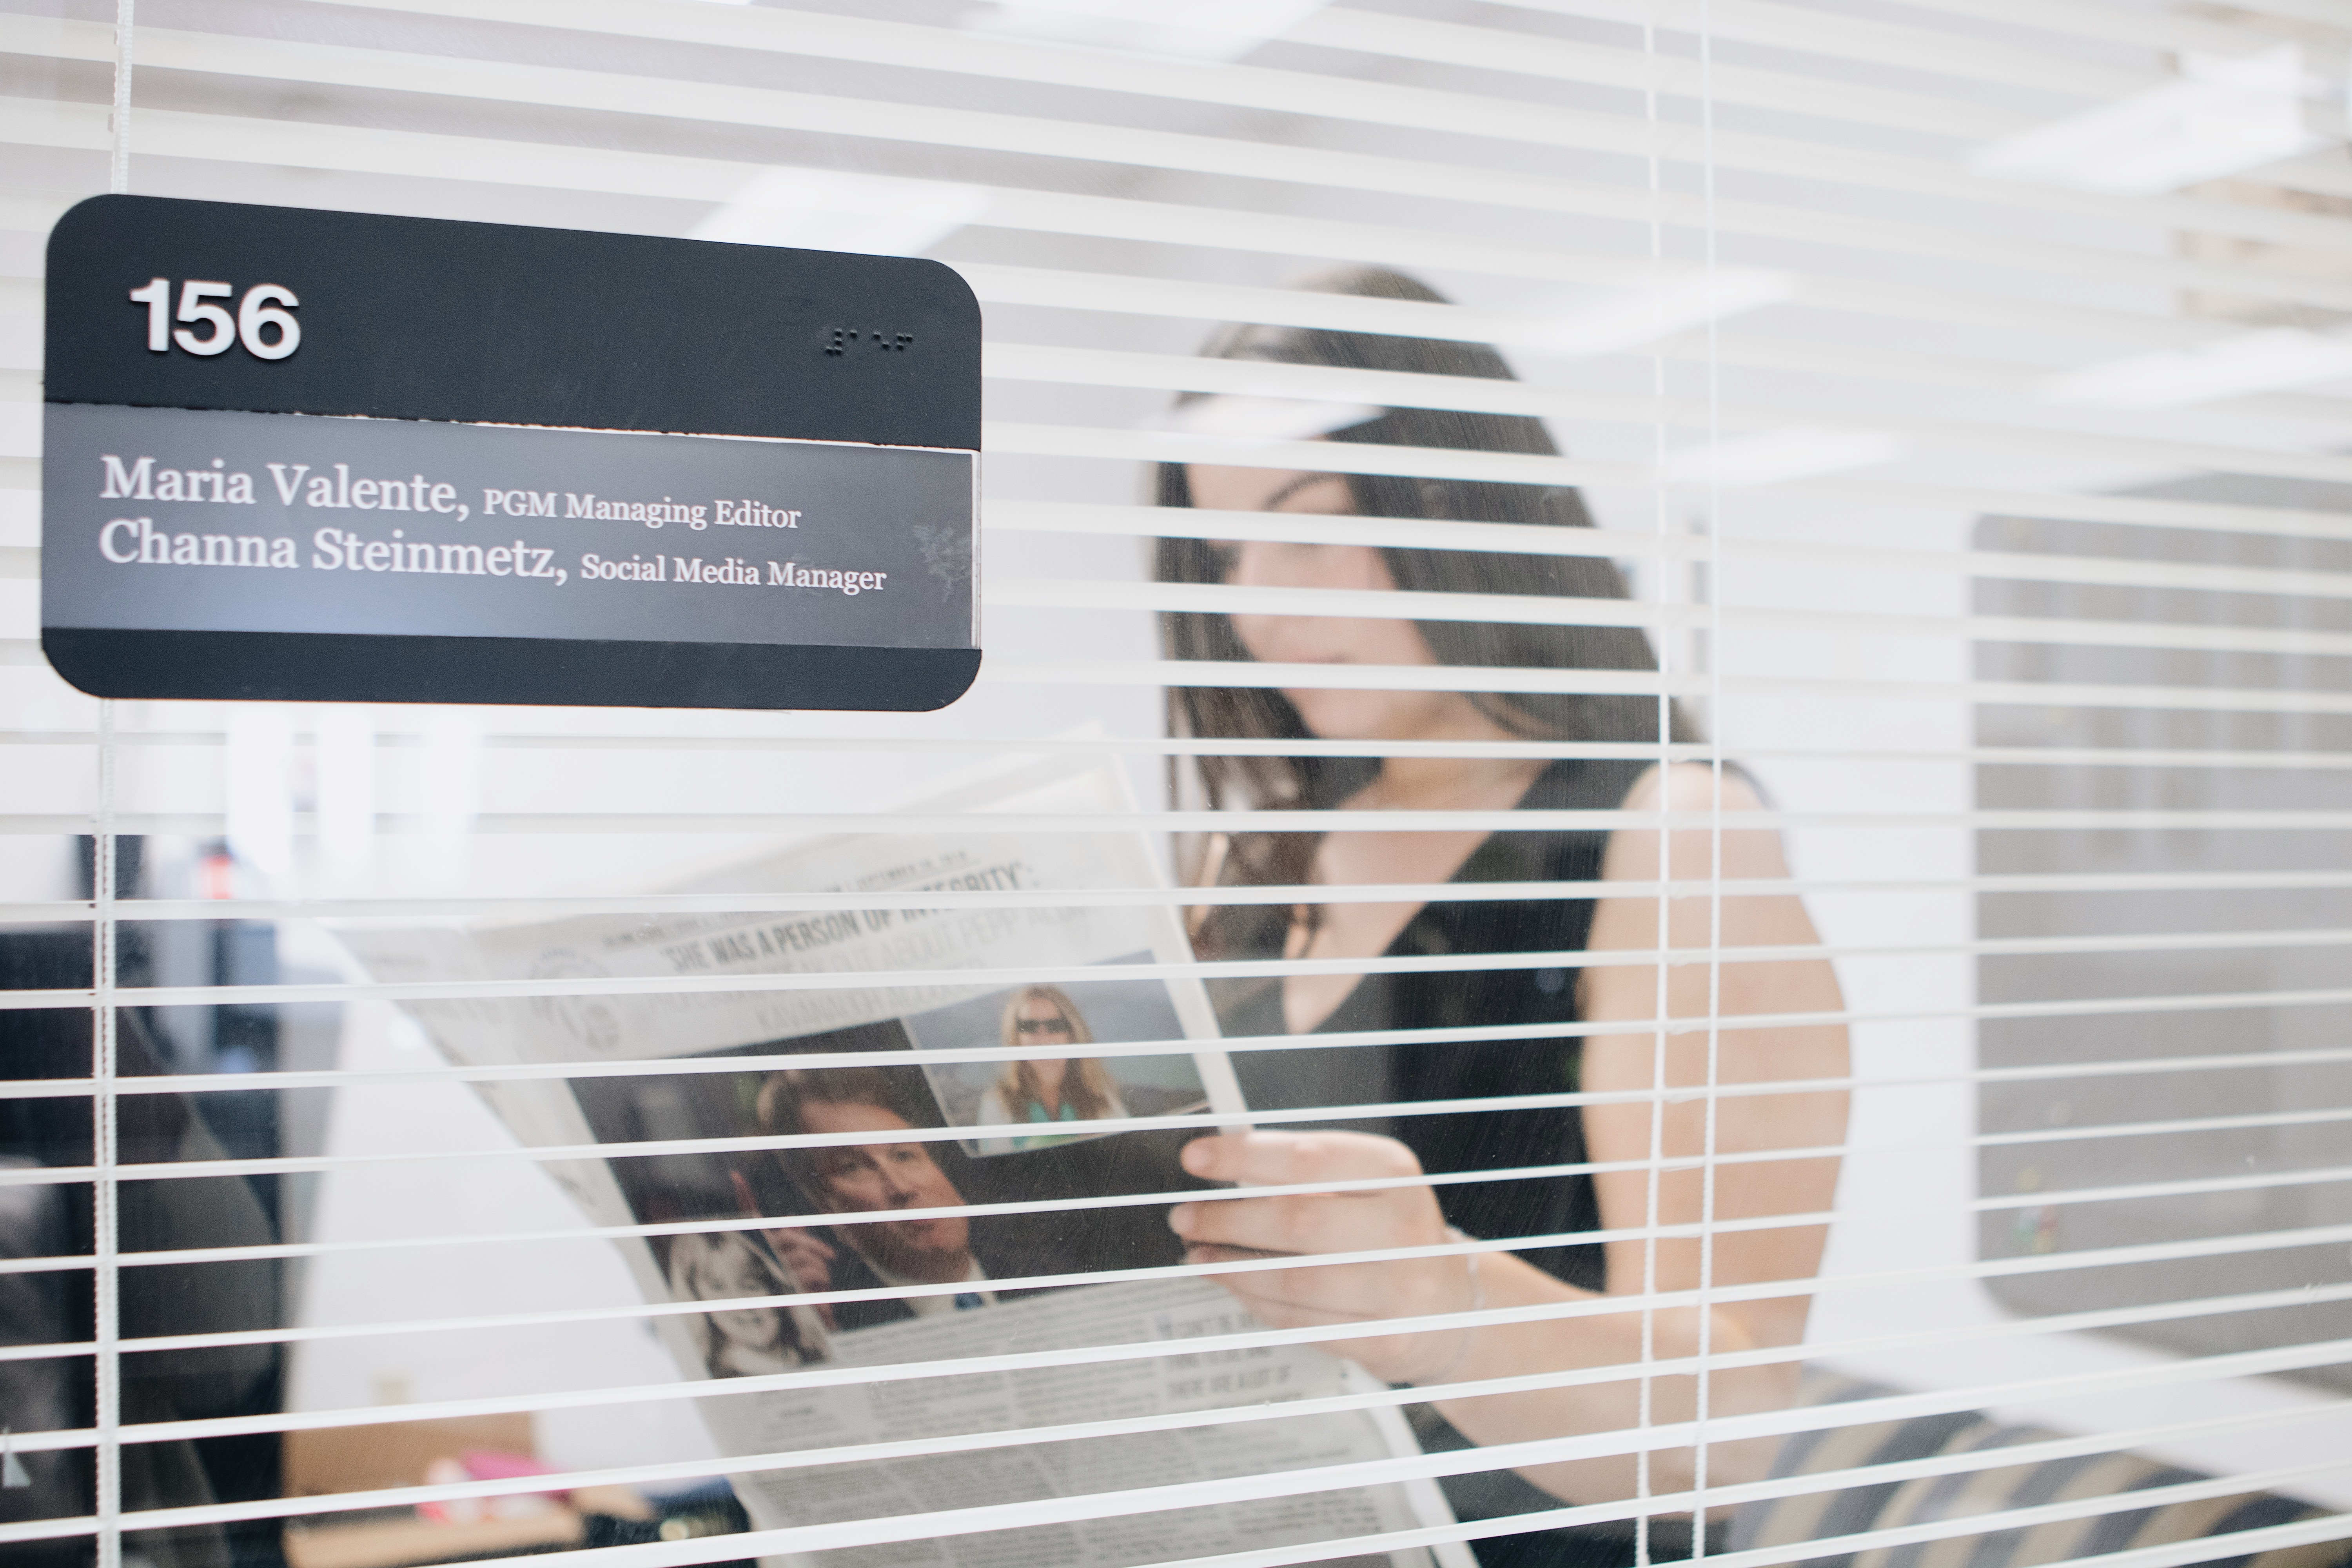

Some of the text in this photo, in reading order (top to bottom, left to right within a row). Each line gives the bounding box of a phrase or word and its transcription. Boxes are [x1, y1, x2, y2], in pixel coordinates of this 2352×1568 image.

[130, 278, 301, 360] 156
[100, 454, 802, 531] Maria Valente, PGM Managing Editor
[99, 518, 887, 596] Channa Steinmetz, Social Media Manager
[707, 931, 757, 965] WAS
[756, 927, 775, 956] A
[771, 908, 861, 955] PERSON
